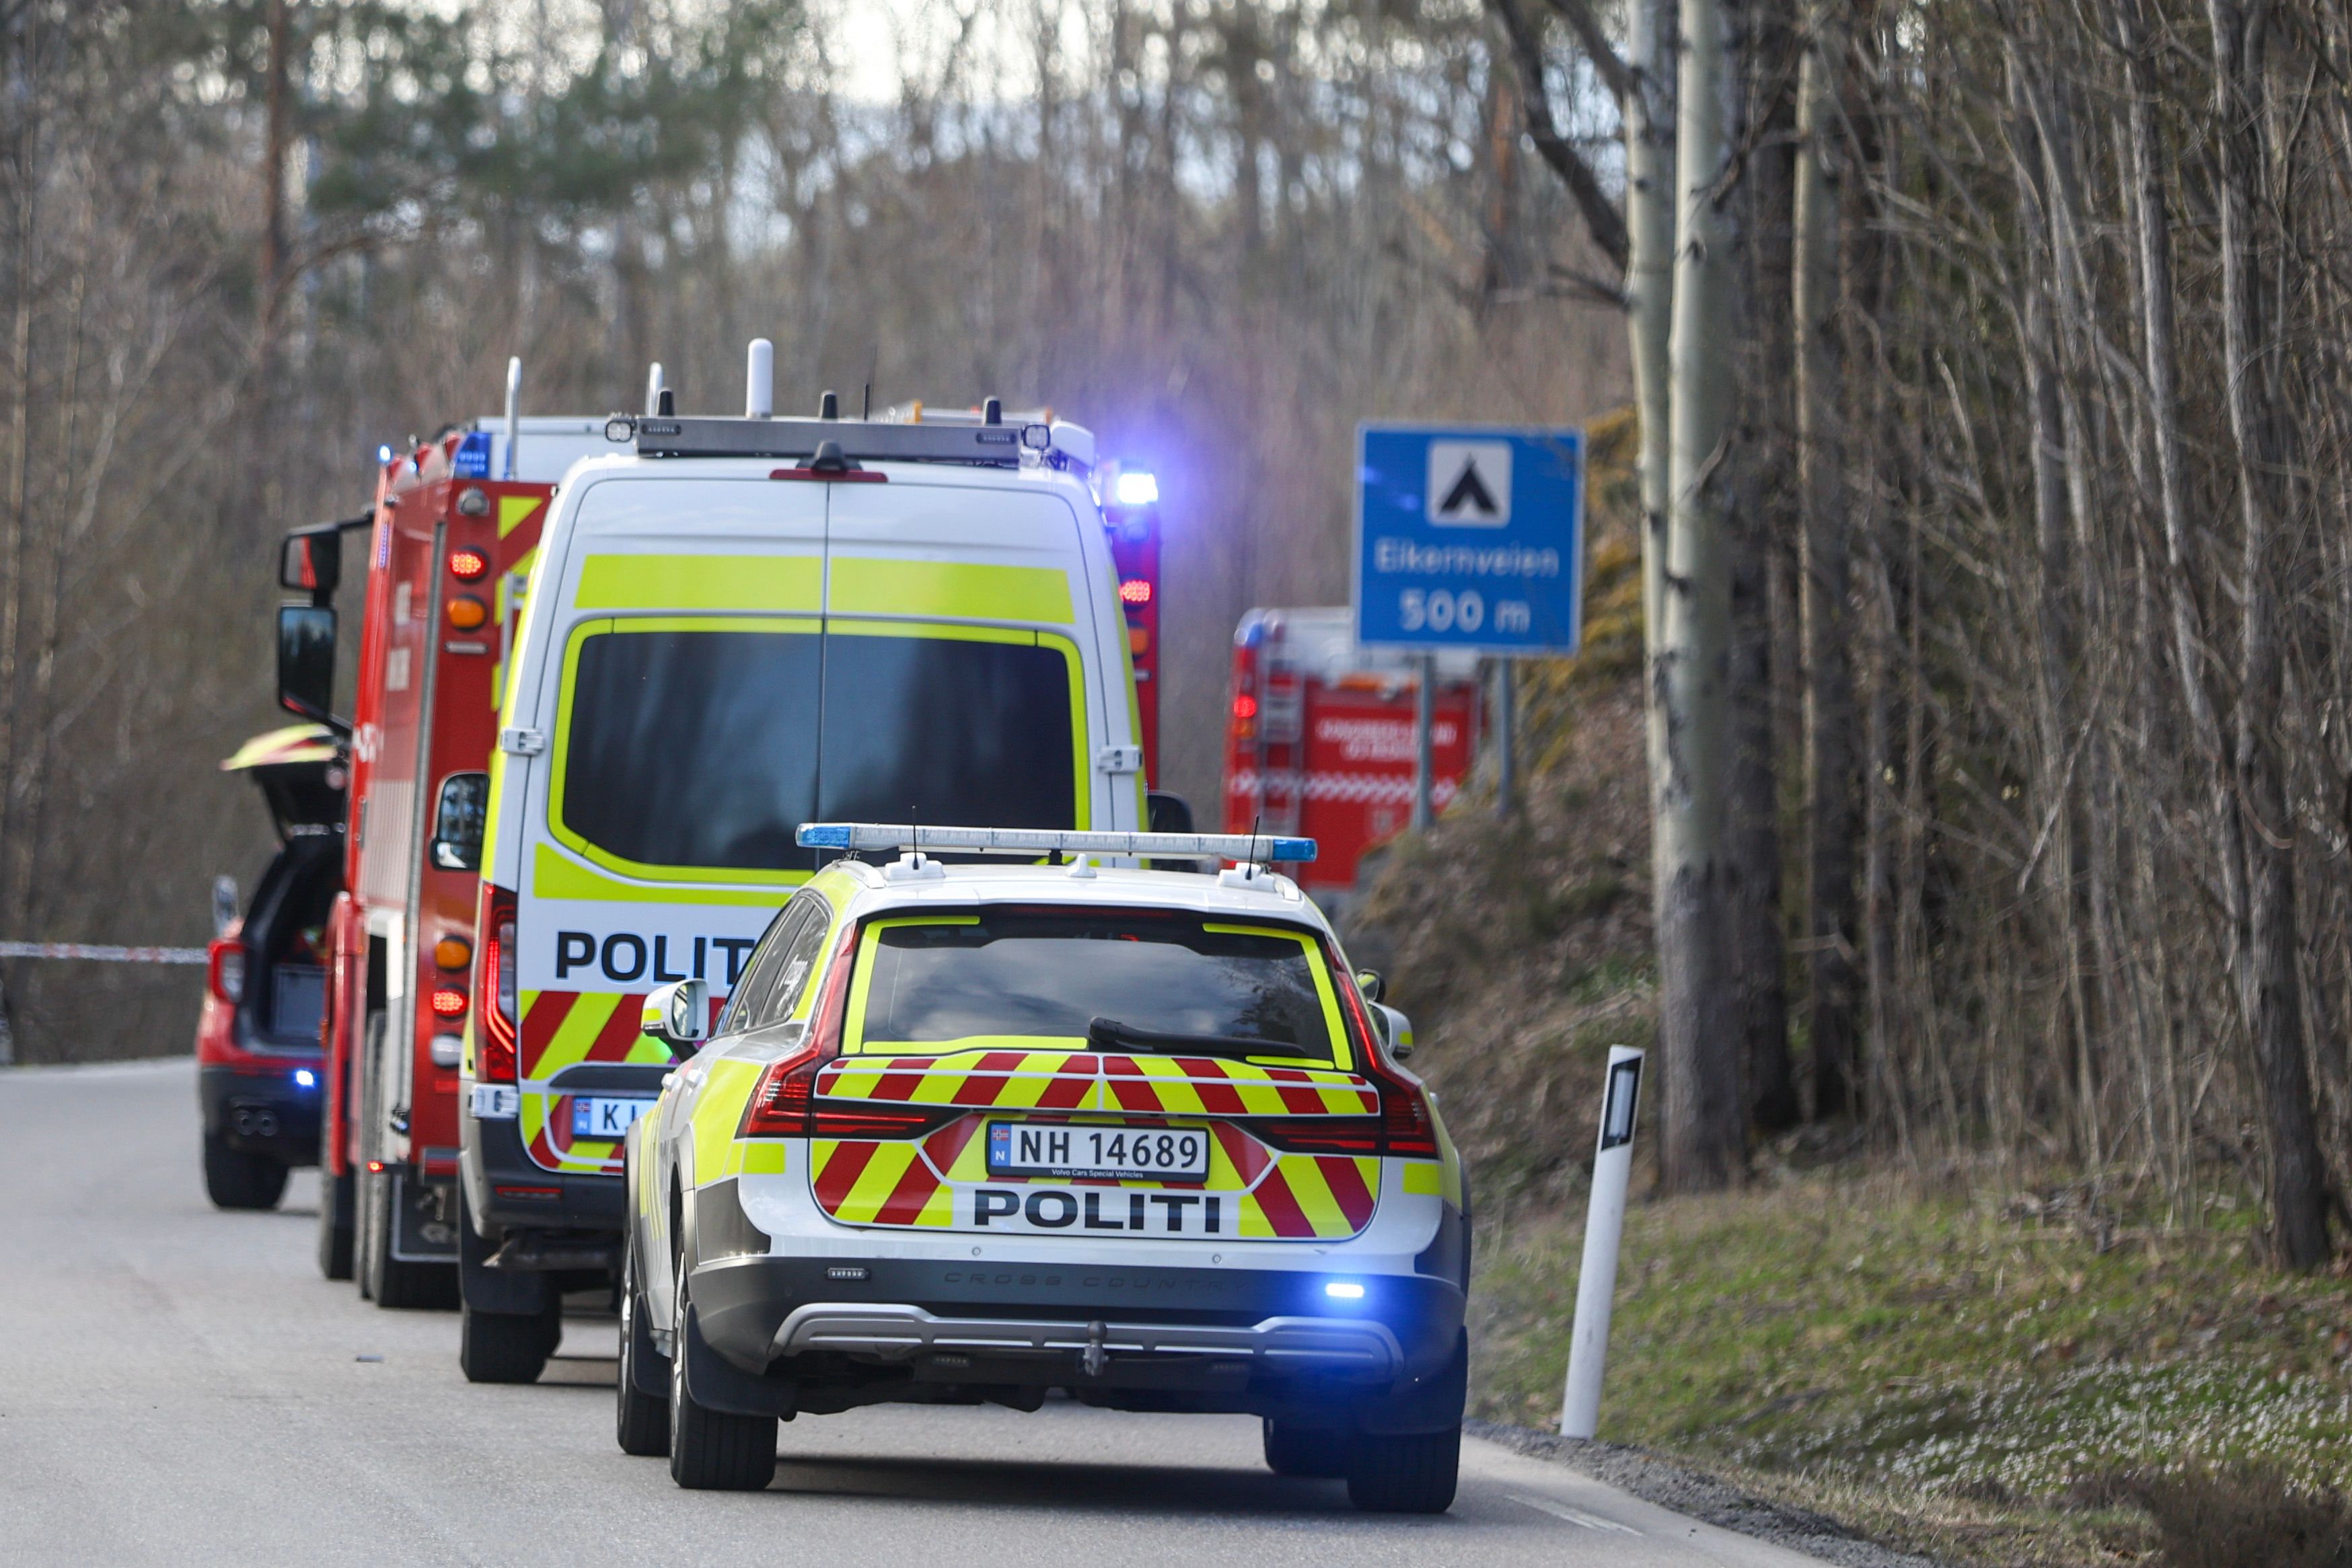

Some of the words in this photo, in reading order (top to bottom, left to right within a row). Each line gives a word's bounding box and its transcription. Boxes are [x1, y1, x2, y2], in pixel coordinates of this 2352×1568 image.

[1399, 587, 1484, 633] 500
[1494, 601, 1531, 633] m
[556, 931, 756, 985] POLIT
[995, 1151, 1005, 1160] N
[1020, 1130, 1069, 1164] NH
[1089, 1133, 1198, 1168] 14689
[1089, 1170, 1114, 1179] Special
[973, 1189, 1220, 1234] POLITI
[944, 1273, 1062, 1286] CROSS
